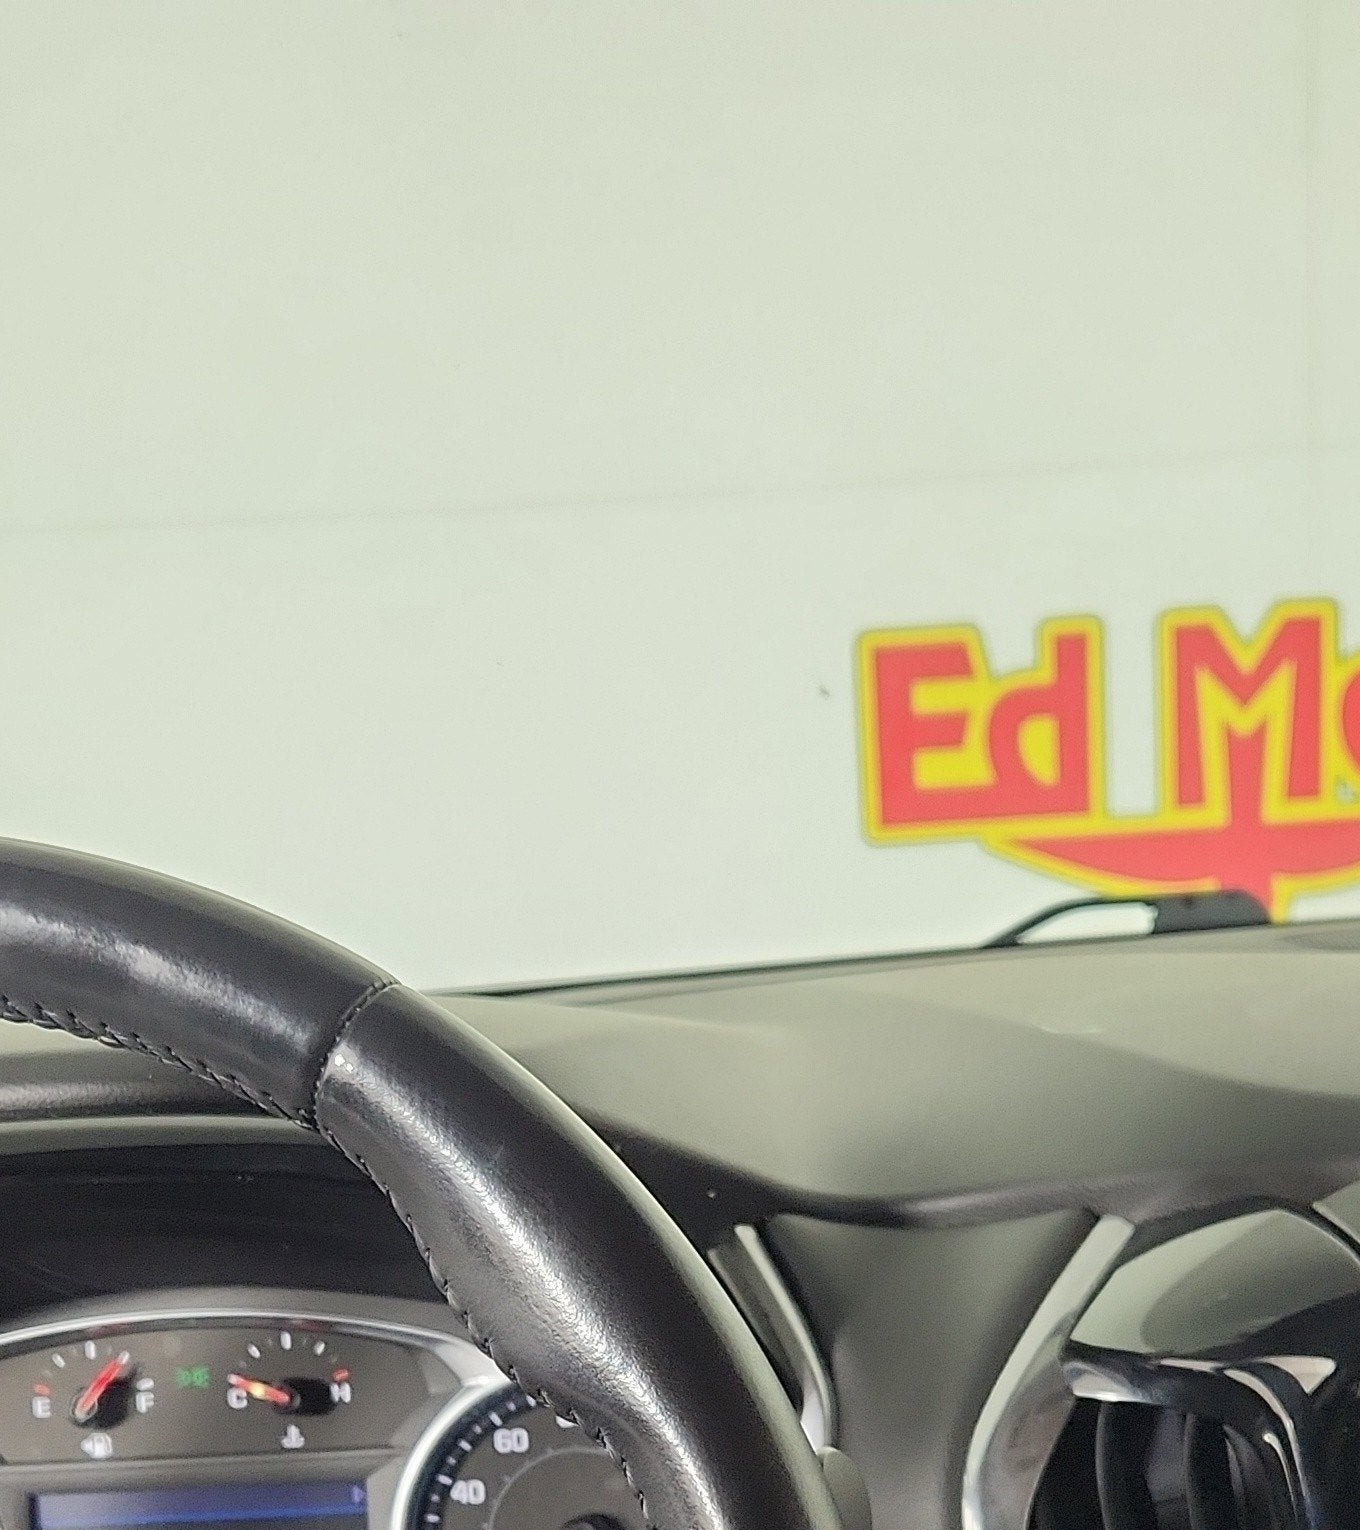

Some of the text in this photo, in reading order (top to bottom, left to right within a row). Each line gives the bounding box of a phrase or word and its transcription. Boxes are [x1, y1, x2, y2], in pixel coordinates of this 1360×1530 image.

[857, 613, 1104, 845] Ed
[32, 1396, 51, 1419] E
[493, 1427, 529, 1454] 60
[451, 1479, 486, 1505] 40
